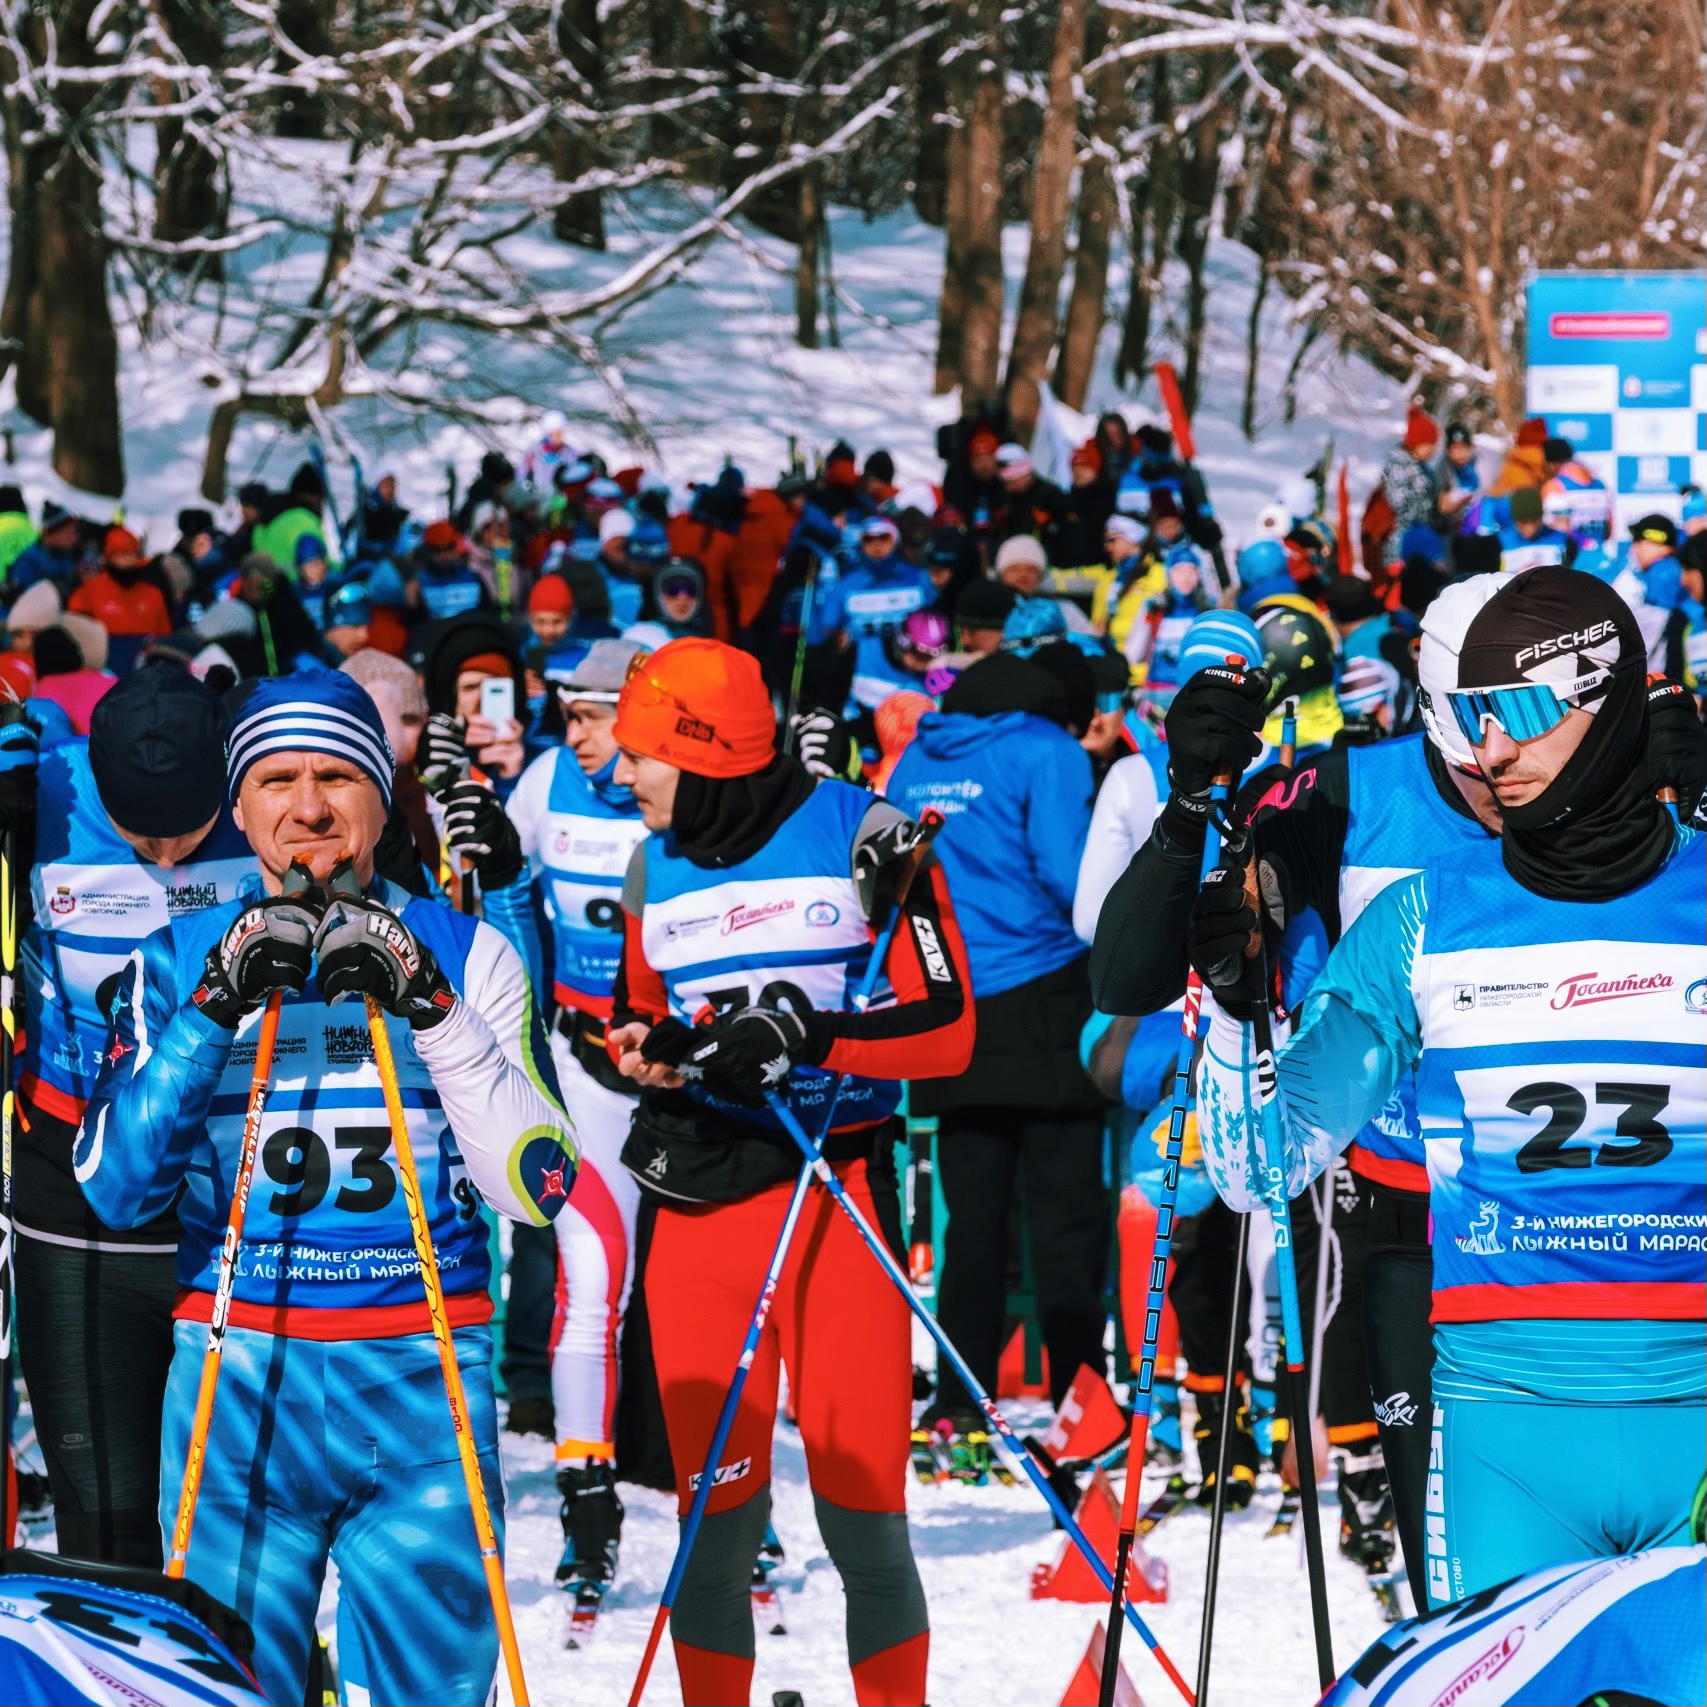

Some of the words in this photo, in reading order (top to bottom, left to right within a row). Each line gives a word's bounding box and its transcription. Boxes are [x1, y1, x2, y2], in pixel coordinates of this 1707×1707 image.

[1514, 620, 1618, 669] FISCHER
[81, 893, 150, 901] АДМИНИСТРАЦИЯ
[81, 900, 111, 908] ГОРОДА
[81, 907, 128, 915] НОВГОРОДА
[220, 908, 263, 974] Haro
[369, 913, 421, 974] Haro
[912, 915, 952, 982] KV+
[1479, 981, 1550, 994] ПРАВИТЕЛЬСТВО
[1479, 991, 1542, 1001] НИЖЕГОРОДСКОЙ
[1479, 1000, 1512, 1008] ОБЛАСТИ
[1550, 972, 1677, 1011] Госаптека
[247, 1090, 267, 1166] WORLD
[1505, 1081, 1674, 1174] 23
[262, 1126, 397, 1217] 93
[239, 1171, 252, 1214] CUP
[453, 1177, 484, 1221] 9
[1136, 1057, 1194, 1395] TORNADO
[1512, 1232, 1628, 1252] ЛЫЖНЫЙ
[252, 1264, 361, 1281] ЛЫЖНЫЙ
[290, 1244, 440, 1263] НИЖЕГОРОДСК
[690, 1461, 750, 1489] KV+
